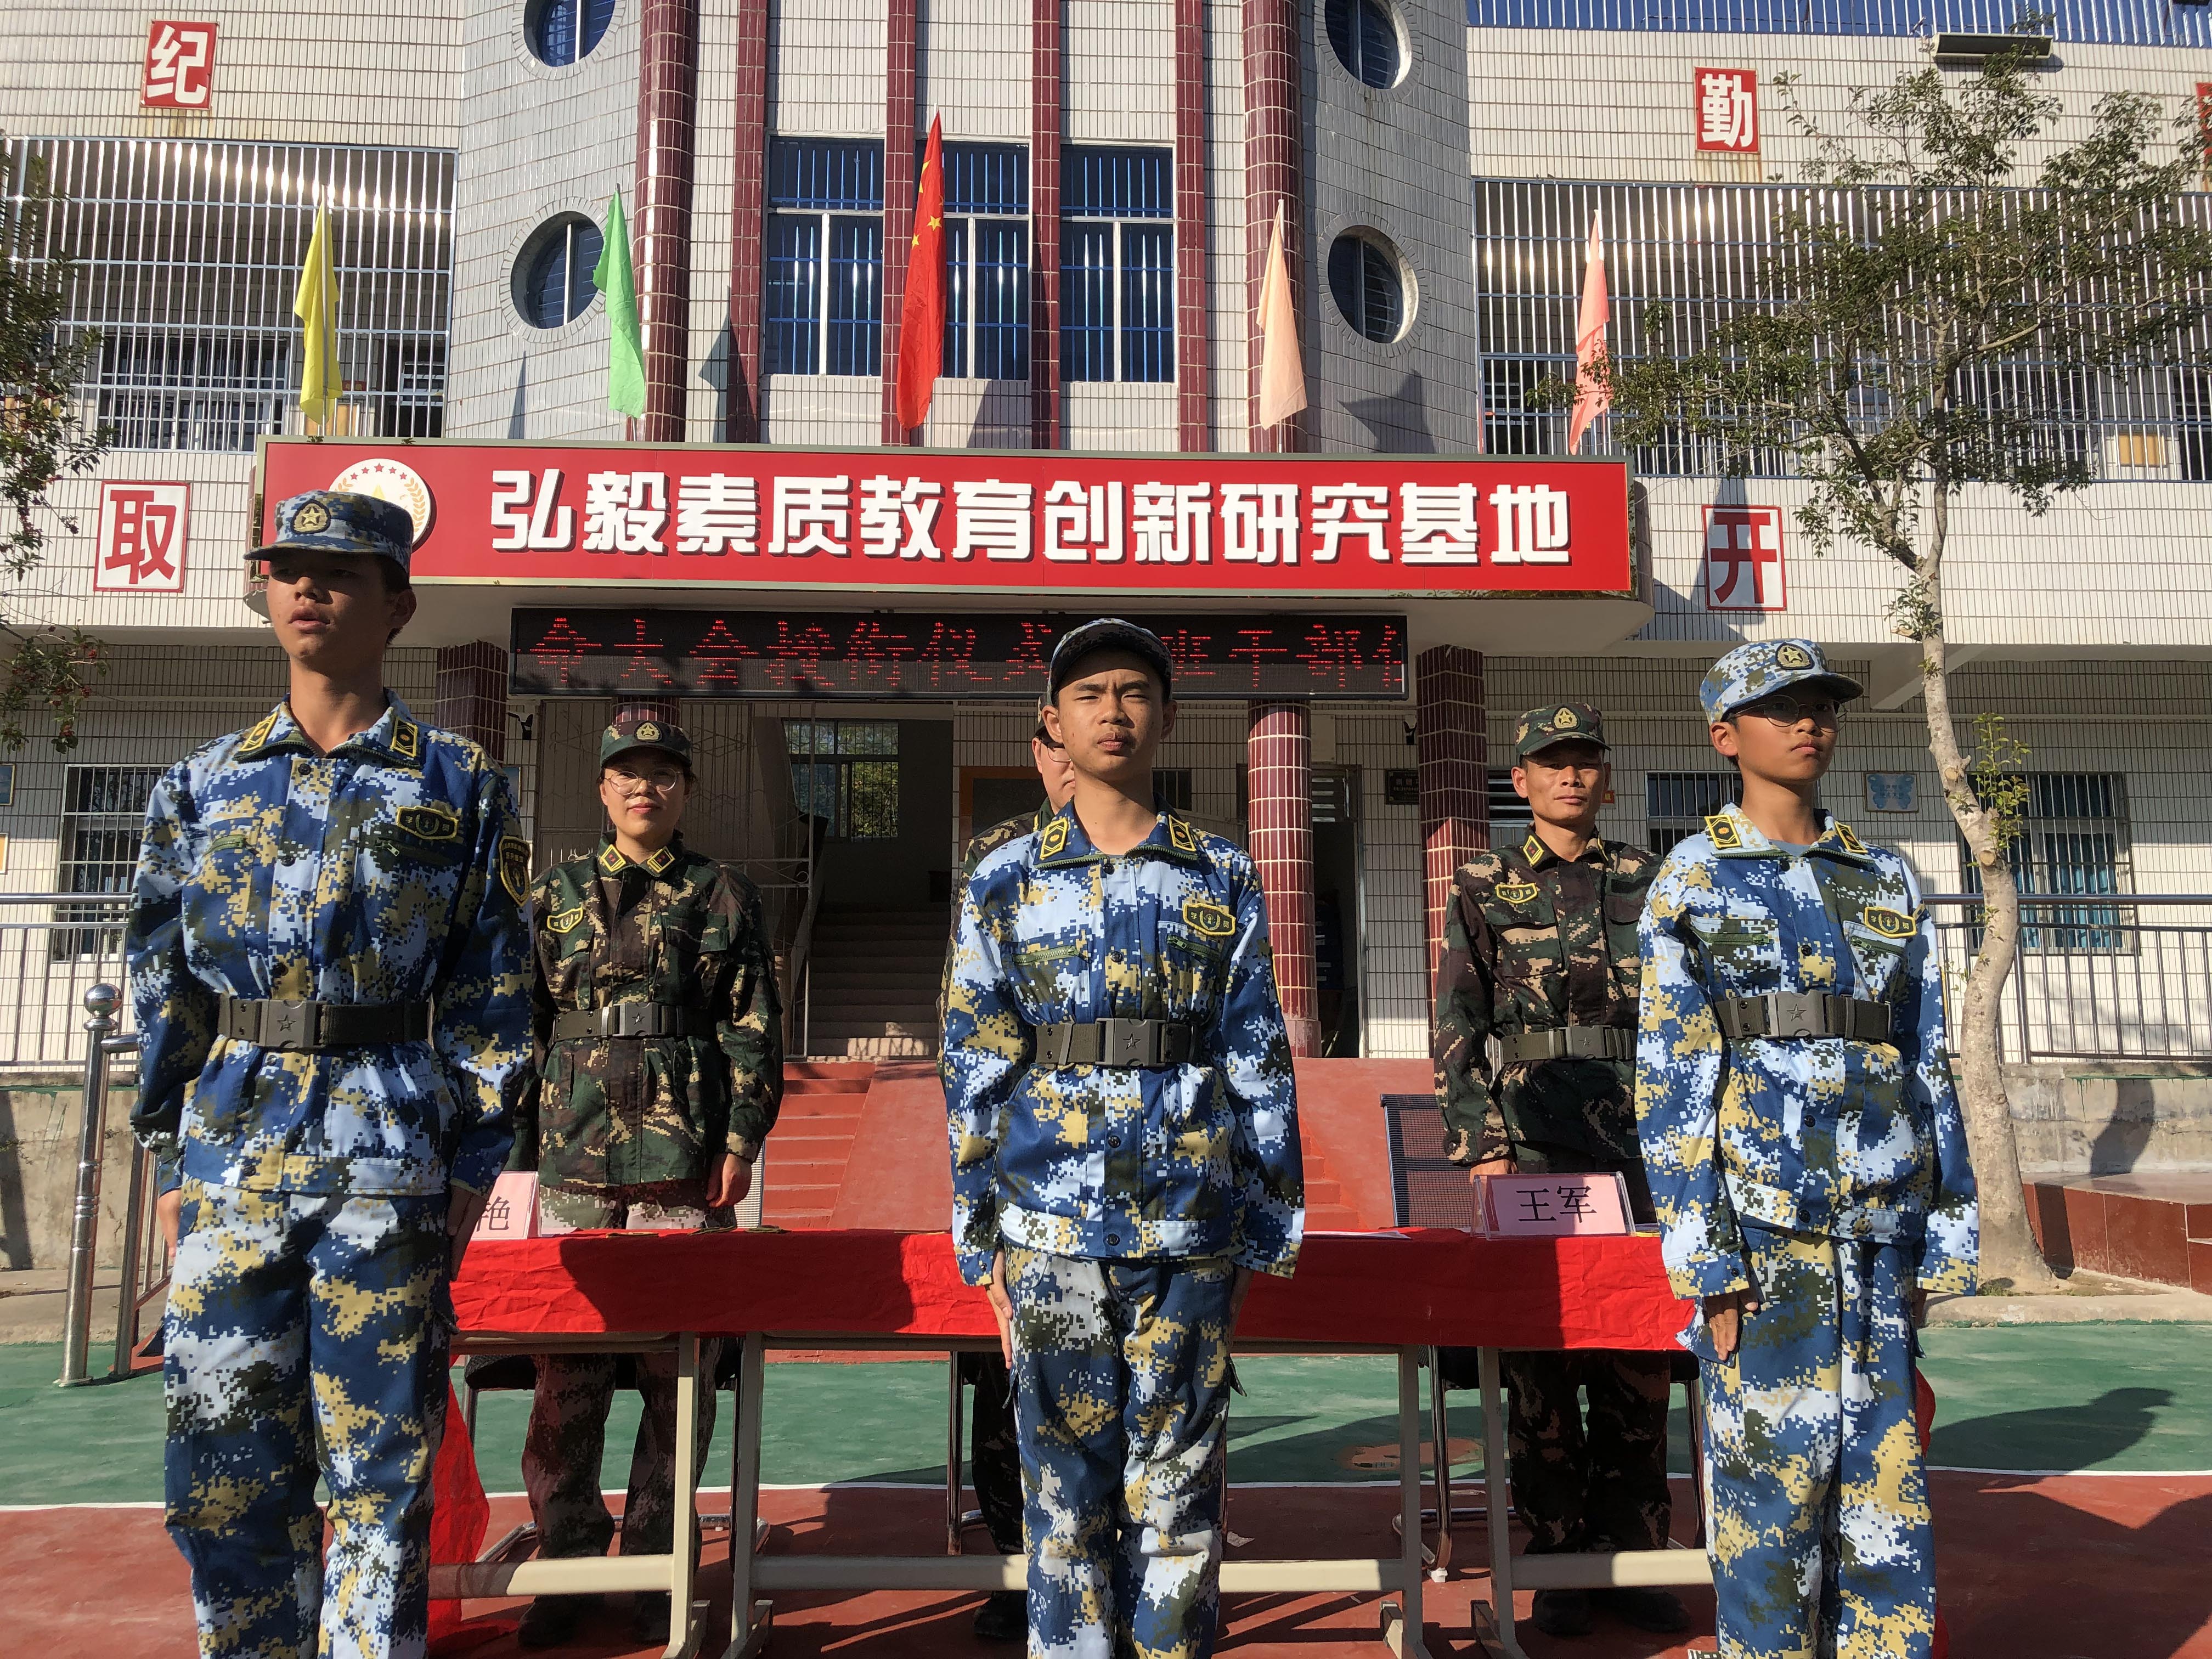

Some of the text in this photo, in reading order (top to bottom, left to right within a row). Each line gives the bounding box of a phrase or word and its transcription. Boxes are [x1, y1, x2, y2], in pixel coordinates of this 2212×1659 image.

[146, 24, 210, 104] 纪
[1701, 72, 1753, 148] 勤
[104, 489, 177, 585] 取
[490, 468, 1570, 565] 弘毅素质教育创新研究基地
[1709, 511, 1778, 604] 开
[1515, 1185, 1598, 1223] 王军
